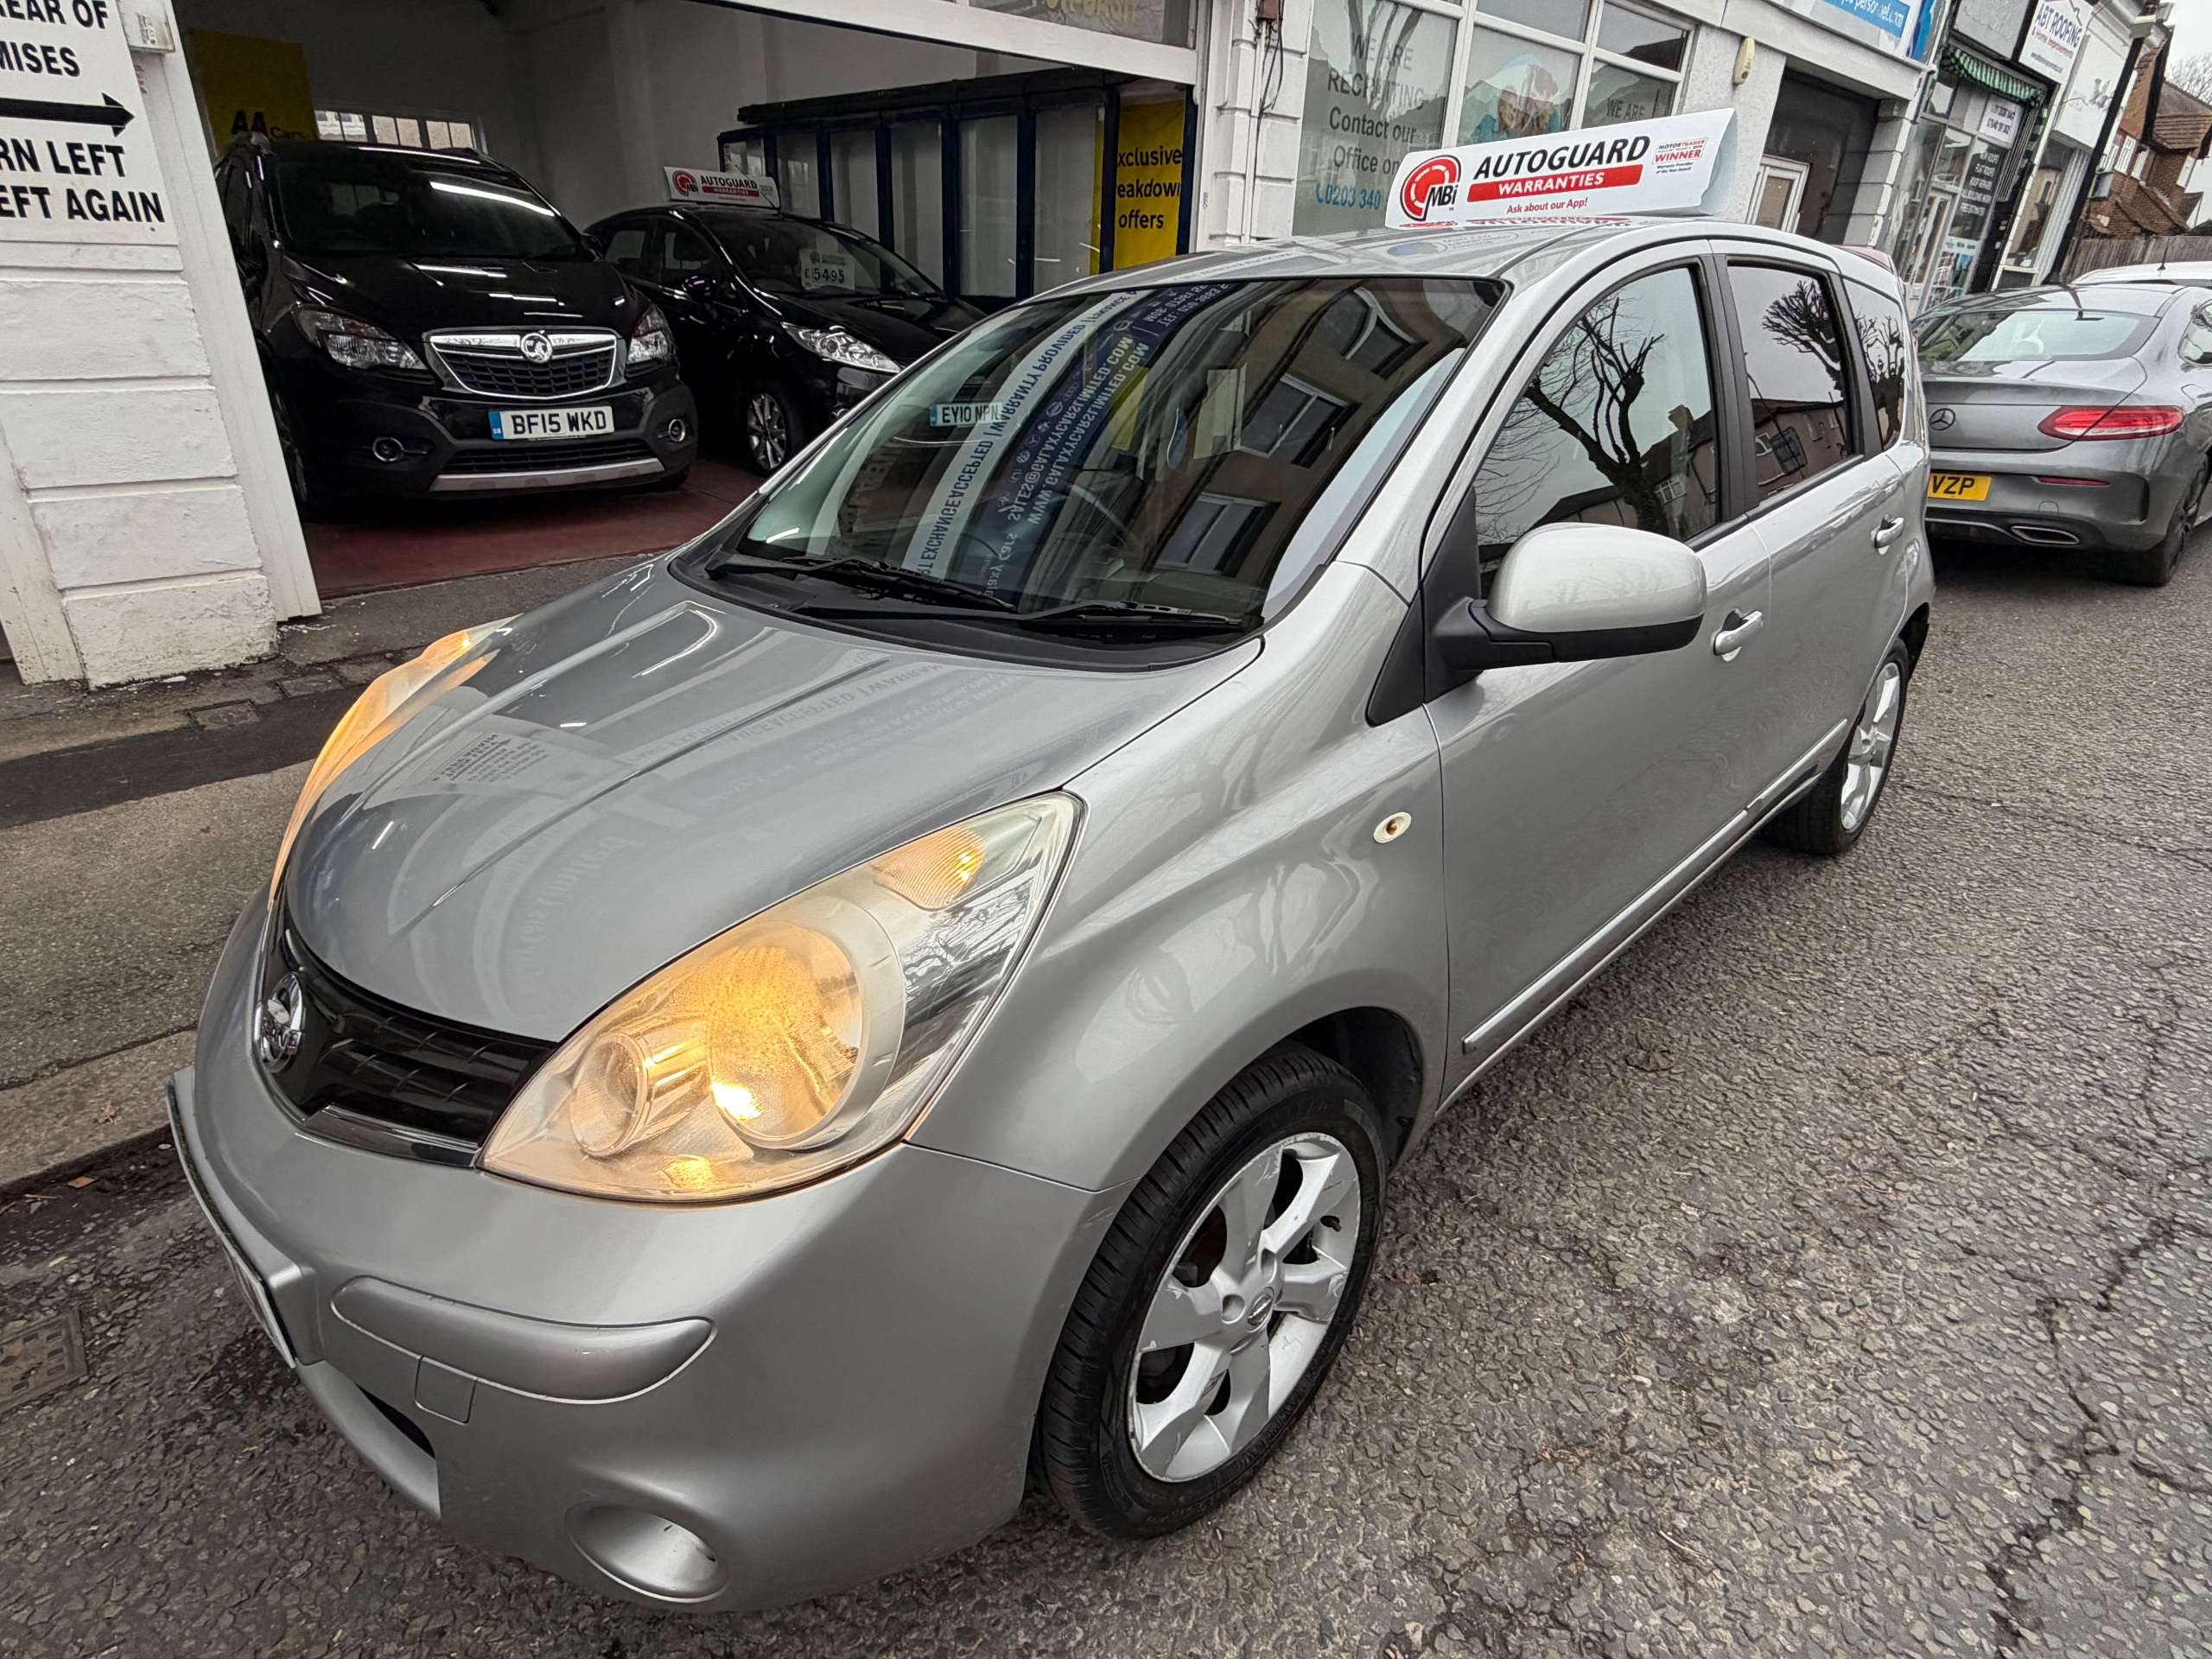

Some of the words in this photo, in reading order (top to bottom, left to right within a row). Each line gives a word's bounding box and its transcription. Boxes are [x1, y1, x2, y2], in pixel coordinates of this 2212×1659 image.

[74, 0, 109, 29] OF
[2035, 3, 2054, 29] ABT
[2049, 12, 2082, 48] ROOFING
[1606, 98, 1624, 118] WE
[1330, 106, 1390, 139] Contact
[1393, 124, 1417, 144] our
[46, 141, 125, 178] LEFT
[1116, 145, 1183, 167] xclusive
[1333, 144, 1378, 172] Office
[1472, 136, 1650, 180] AUTOGUARD
[1656, 149, 1701, 162] WINNER
[700, 175, 758, 189] AUTOGUARD
[1498, 172, 1605, 195] WARRANTIES
[66, 188, 165, 223] AGAIN
[1325, 183, 1355, 207] 0203
[1359, 187, 1382, 210] 340
[1428, 185, 1459, 207] MBi
[1507, 204, 1522, 214] Ask
[1524, 201, 1548, 212] about
[1550, 200, 1566, 210] our
[1566, 197, 1588, 209] App!
[1118, 209, 1165, 229] offers
[512, 412, 561, 435] BF15
[566, 410, 607, 432] WKD
[942, 405, 971, 423] EY10
[1932, 476, 1974, 495] VZP
